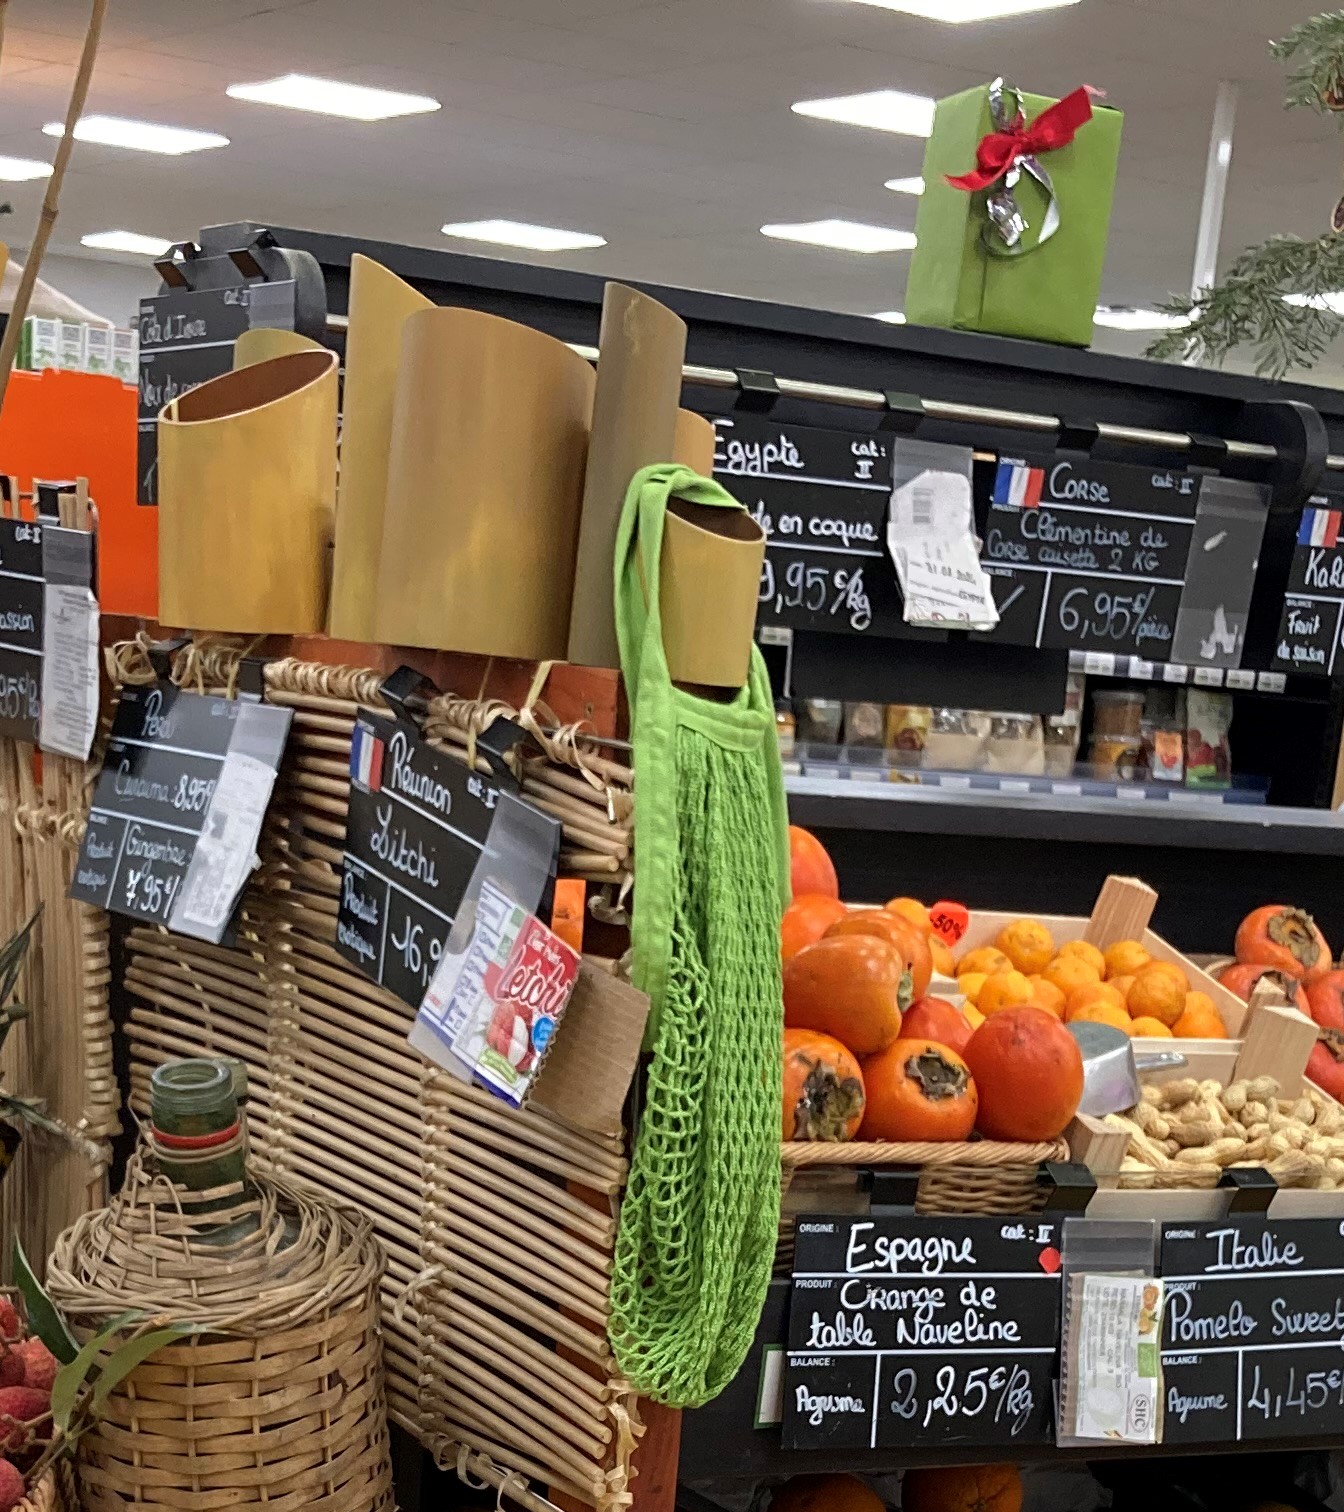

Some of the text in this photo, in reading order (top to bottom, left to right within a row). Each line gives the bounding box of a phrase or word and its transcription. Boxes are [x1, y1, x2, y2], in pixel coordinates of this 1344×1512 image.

[1049, 462, 1110, 503] Corse
[779, 514, 878, 546] en coque
[1140, 526, 1168, 549] de
[1108, 549, 1122, 571] 2
[389, 731, 451, 814] Réunion
[370, 804, 439, 888] Litchi
[799, 1223, 834, 1233] ORIGINE
[846, 1222, 976, 1275] Espagne
[1204, 1228, 1304, 1272] Italie
[795, 1279, 833, 1289] PRODUIT
[840, 1279, 997, 1323] Orange de
[806, 1310, 1021, 1348] table Naveline
[1164, 1288, 1258, 1342] Pomelo
[790, 1357, 830, 1367] BALANCE
[1134, 1398, 1147, 1429] SHC
